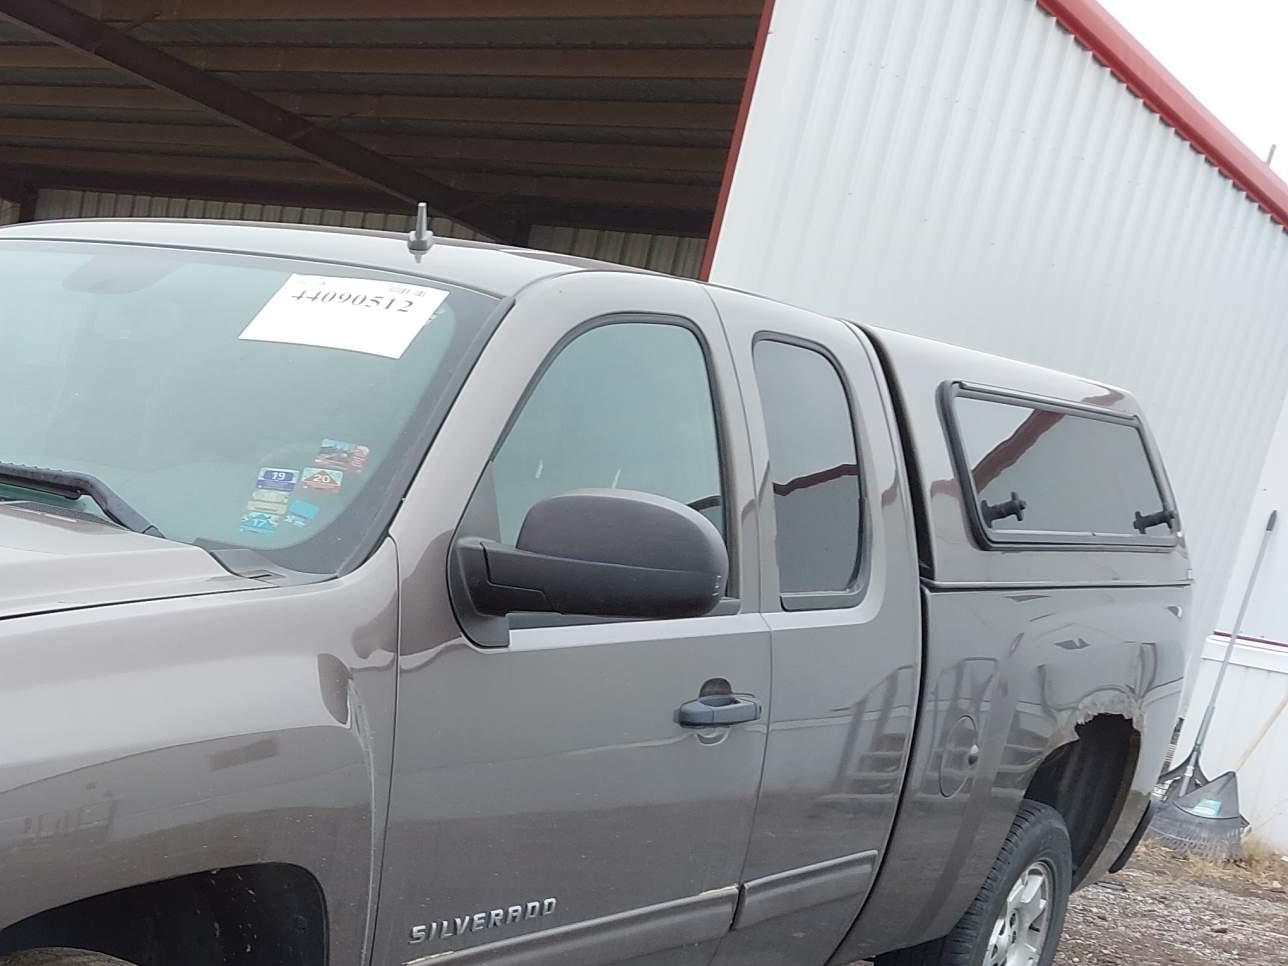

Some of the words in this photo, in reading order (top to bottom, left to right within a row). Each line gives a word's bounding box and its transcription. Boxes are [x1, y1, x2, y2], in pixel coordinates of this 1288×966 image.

[291, 289, 414, 313] 44090512
[271, 472, 286, 481] 19
[313, 473, 331, 483] 20
[409, 897, 557, 944] SILVERADO
